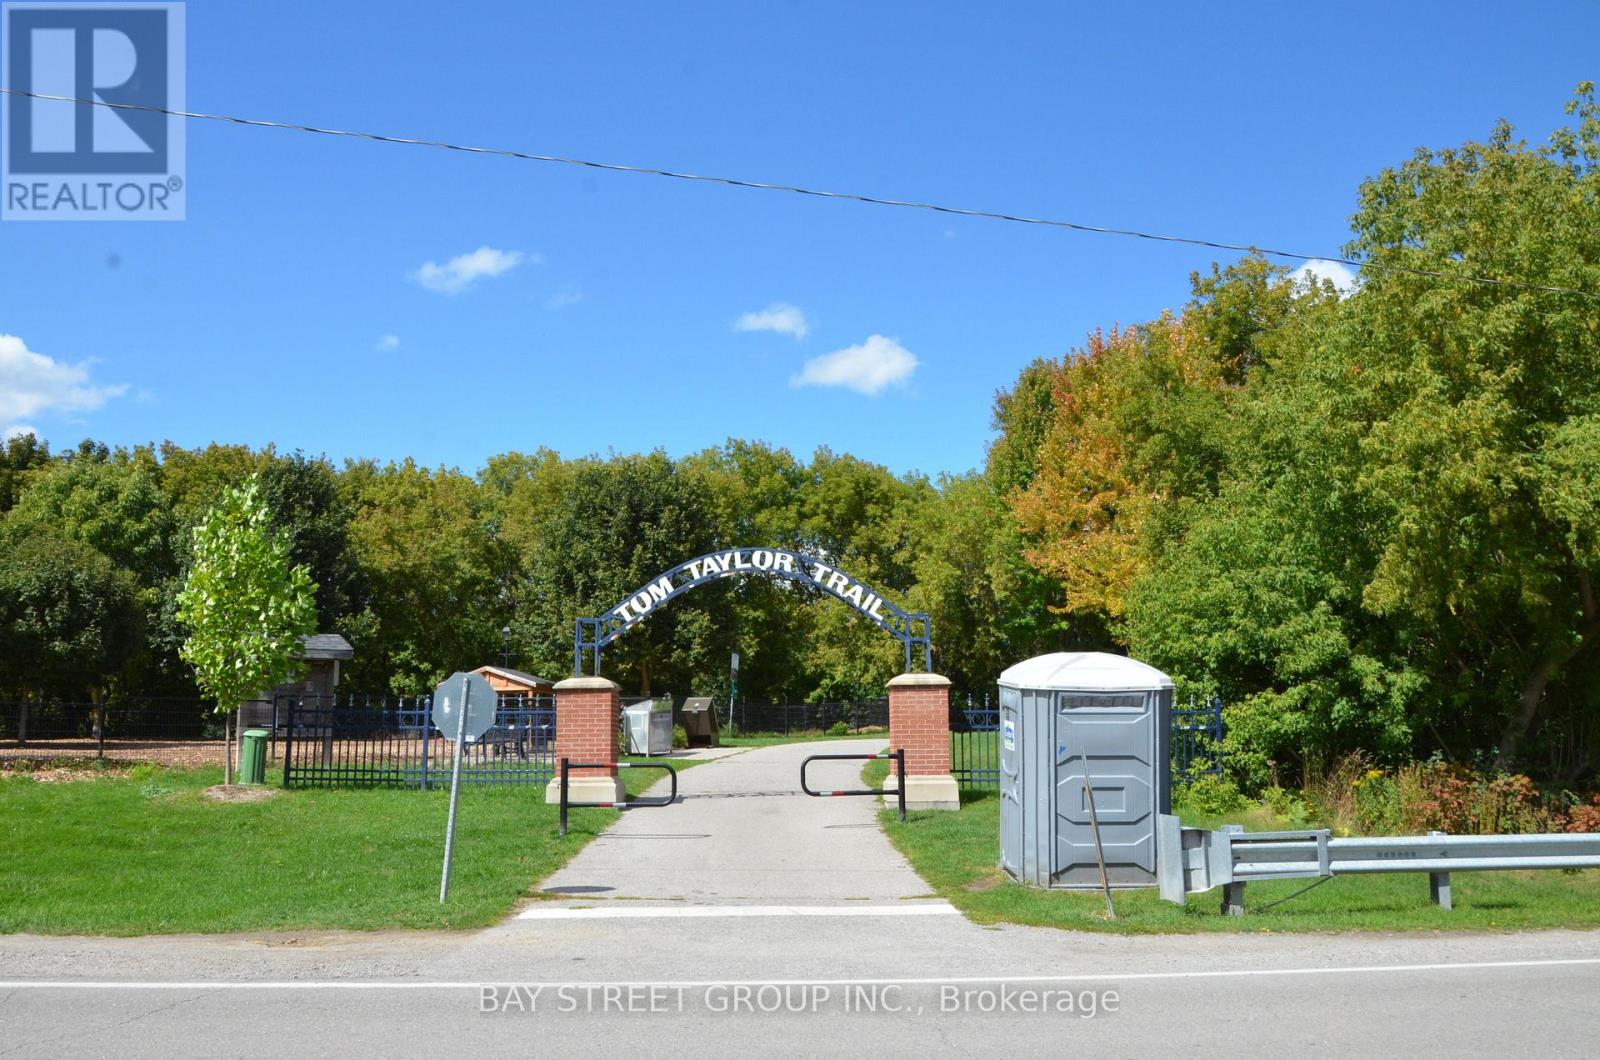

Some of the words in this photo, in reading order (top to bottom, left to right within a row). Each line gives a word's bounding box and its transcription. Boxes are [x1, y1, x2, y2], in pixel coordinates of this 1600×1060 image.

[613, 576, 675, 624] TOM
[683, 550, 794, 581] TAYLOR
[813, 564, 886, 622] TRAIL
